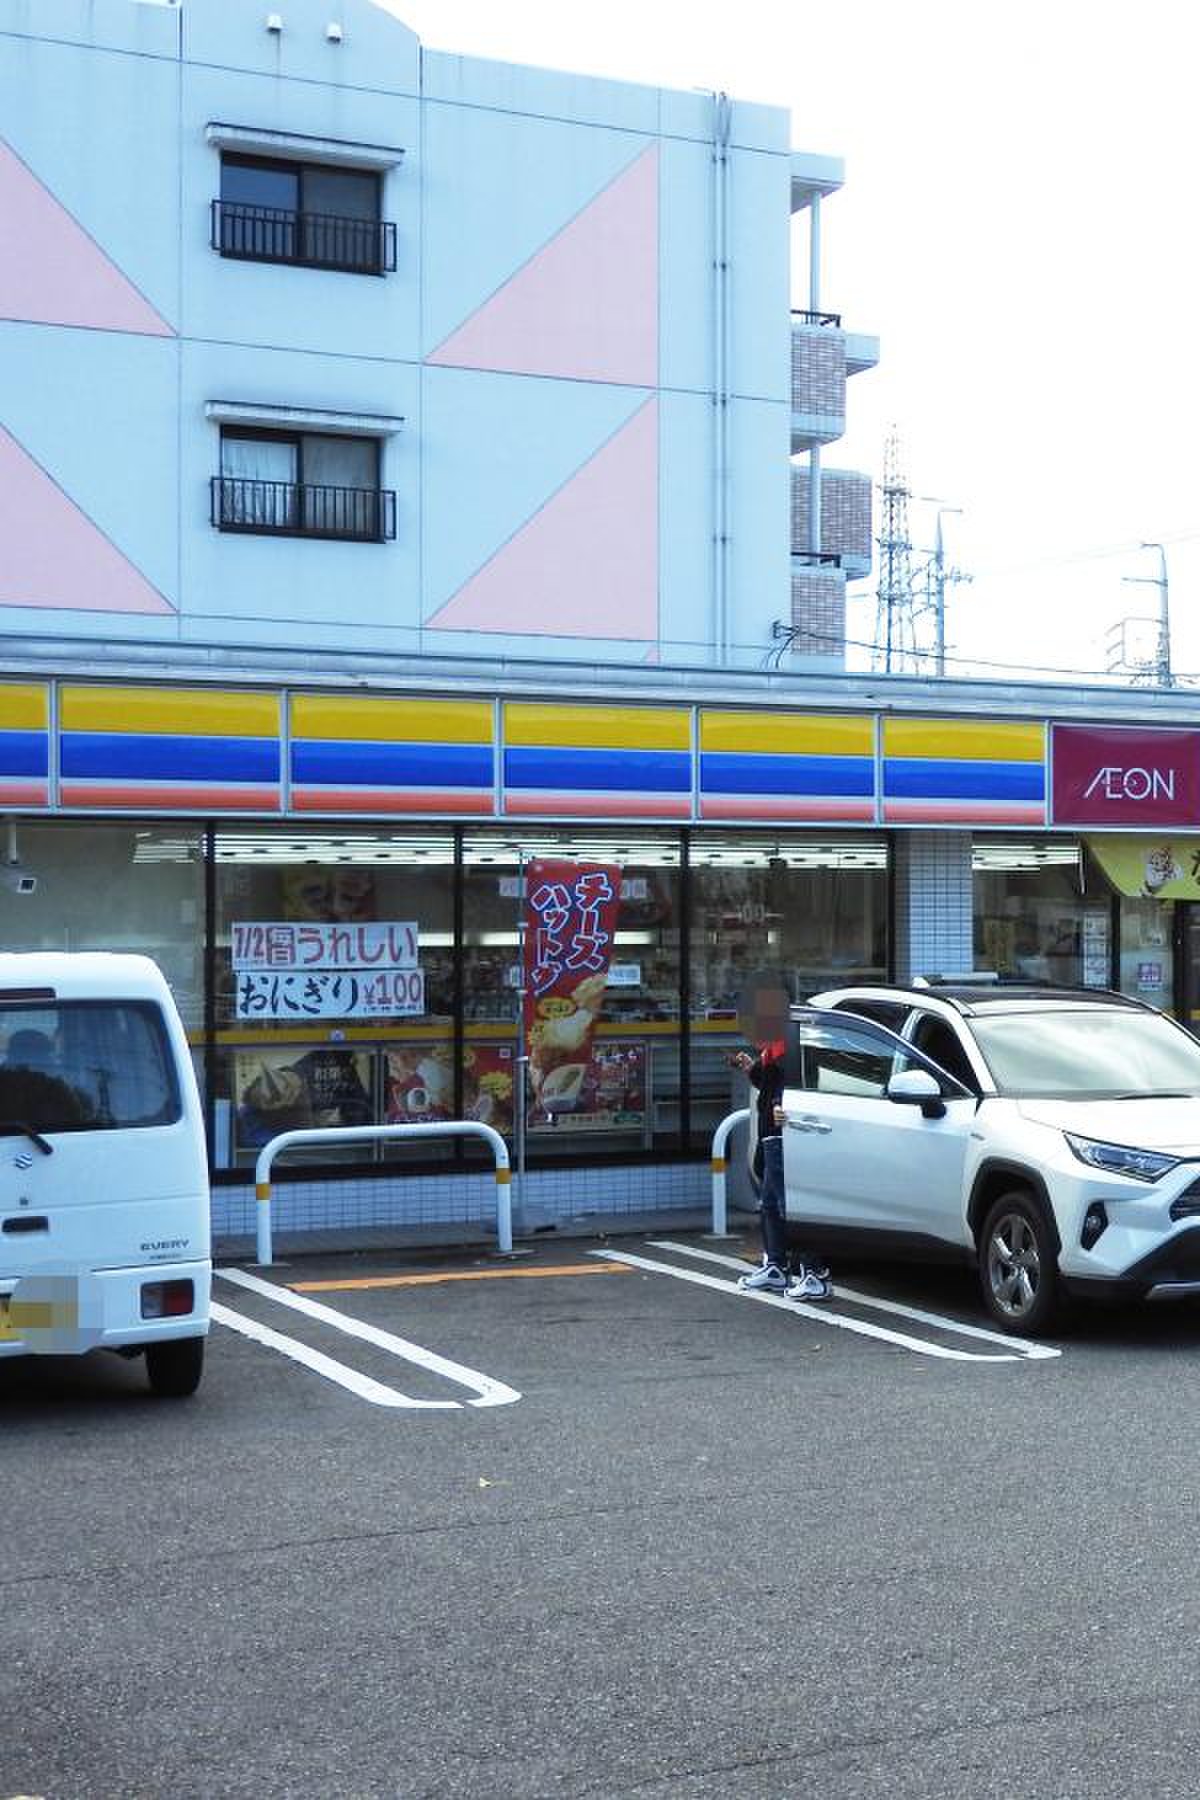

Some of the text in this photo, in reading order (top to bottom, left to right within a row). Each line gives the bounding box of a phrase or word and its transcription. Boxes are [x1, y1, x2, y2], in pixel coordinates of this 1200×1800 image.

[564, 872, 613, 971] チーズ
[239, 974, 359, 1015] おにぎり
[140, 1239, 190, 1251] EVERY
